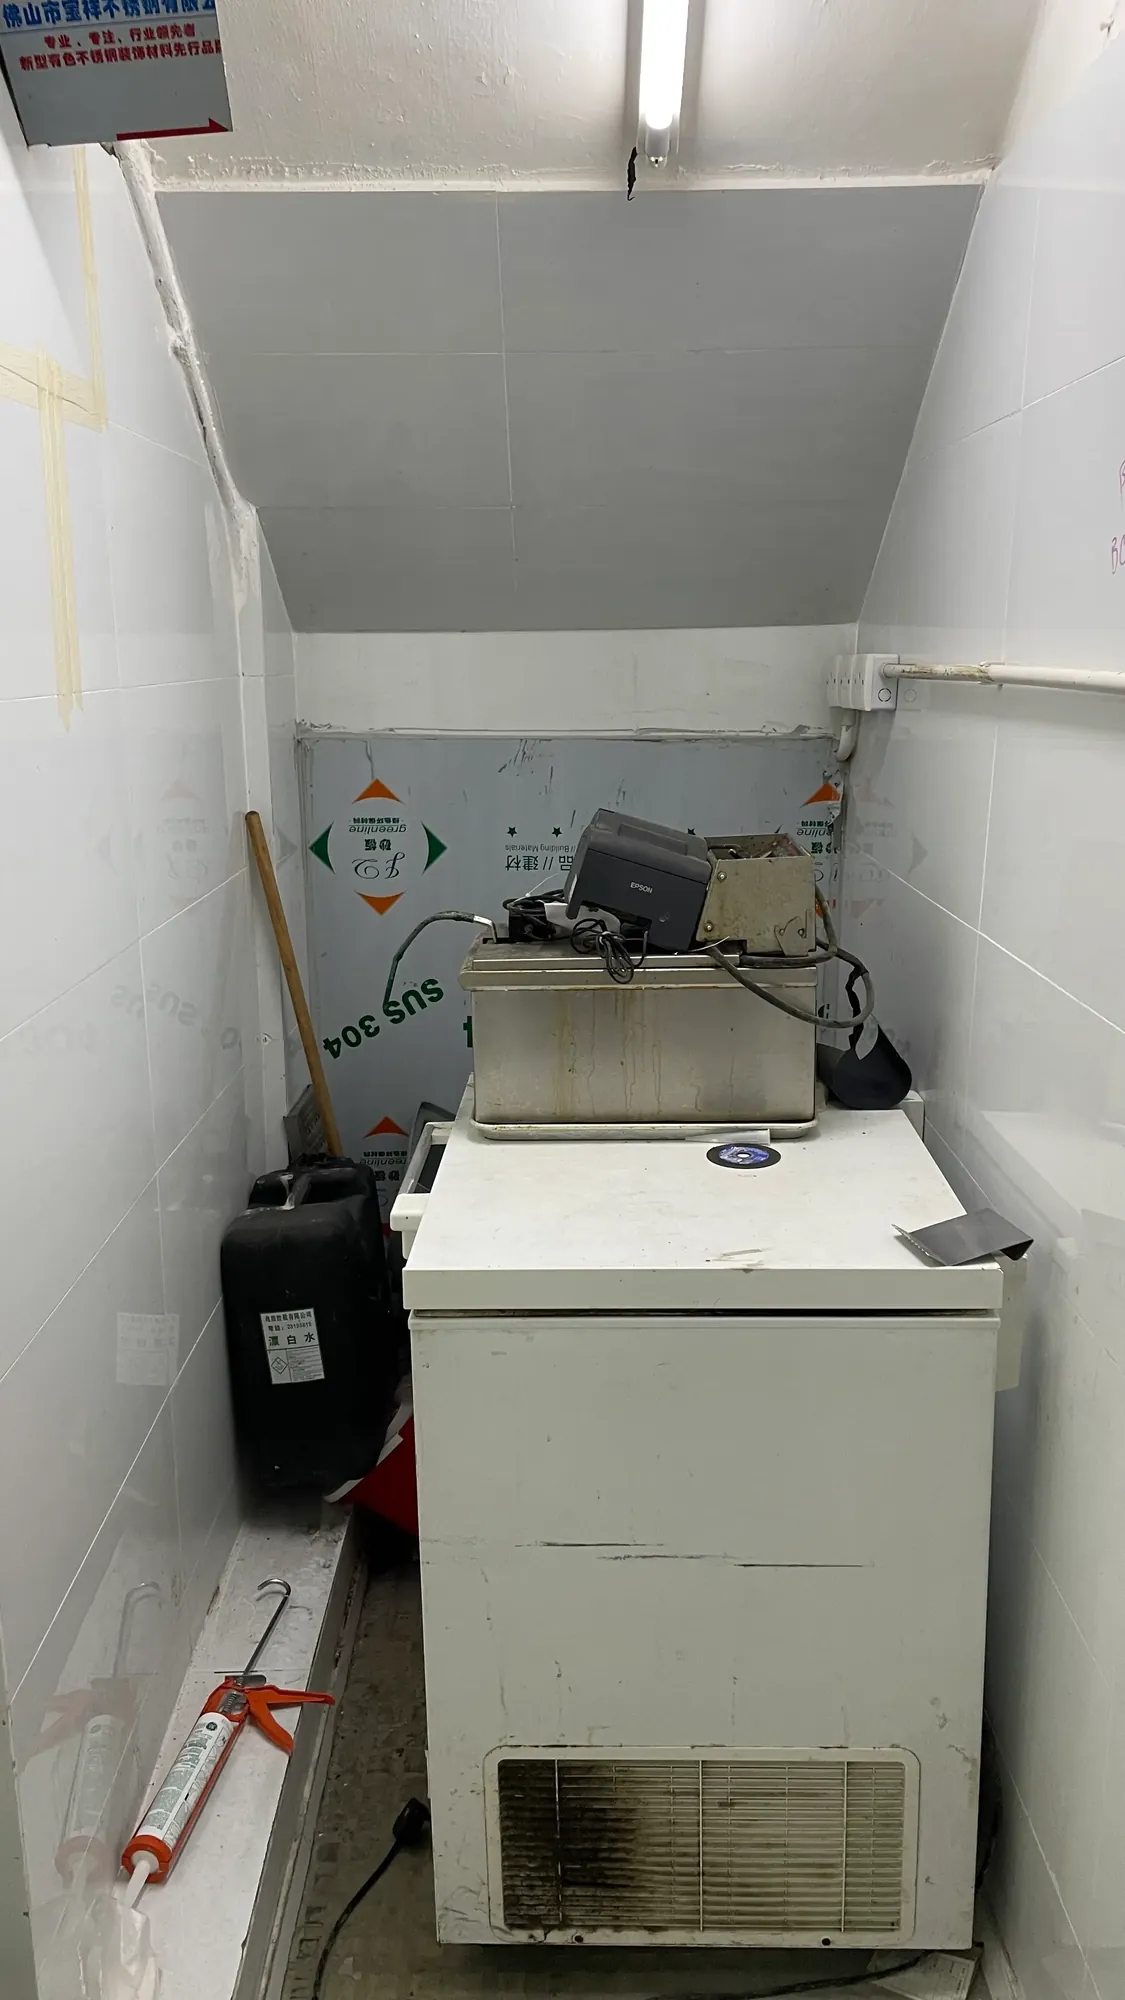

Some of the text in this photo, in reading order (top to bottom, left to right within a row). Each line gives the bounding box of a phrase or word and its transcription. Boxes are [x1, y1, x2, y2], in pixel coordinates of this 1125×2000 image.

[349, 824, 407, 835] greenline
[504, 844, 539, 853] Materials
[540, 844, 570, 853] Building
[505, 855, 539, 871] 建材
[630, 881, 654, 894] EPSON
[322, 978, 444, 1060] SUS 304
[359, 1158, 406, 1167] reenline
